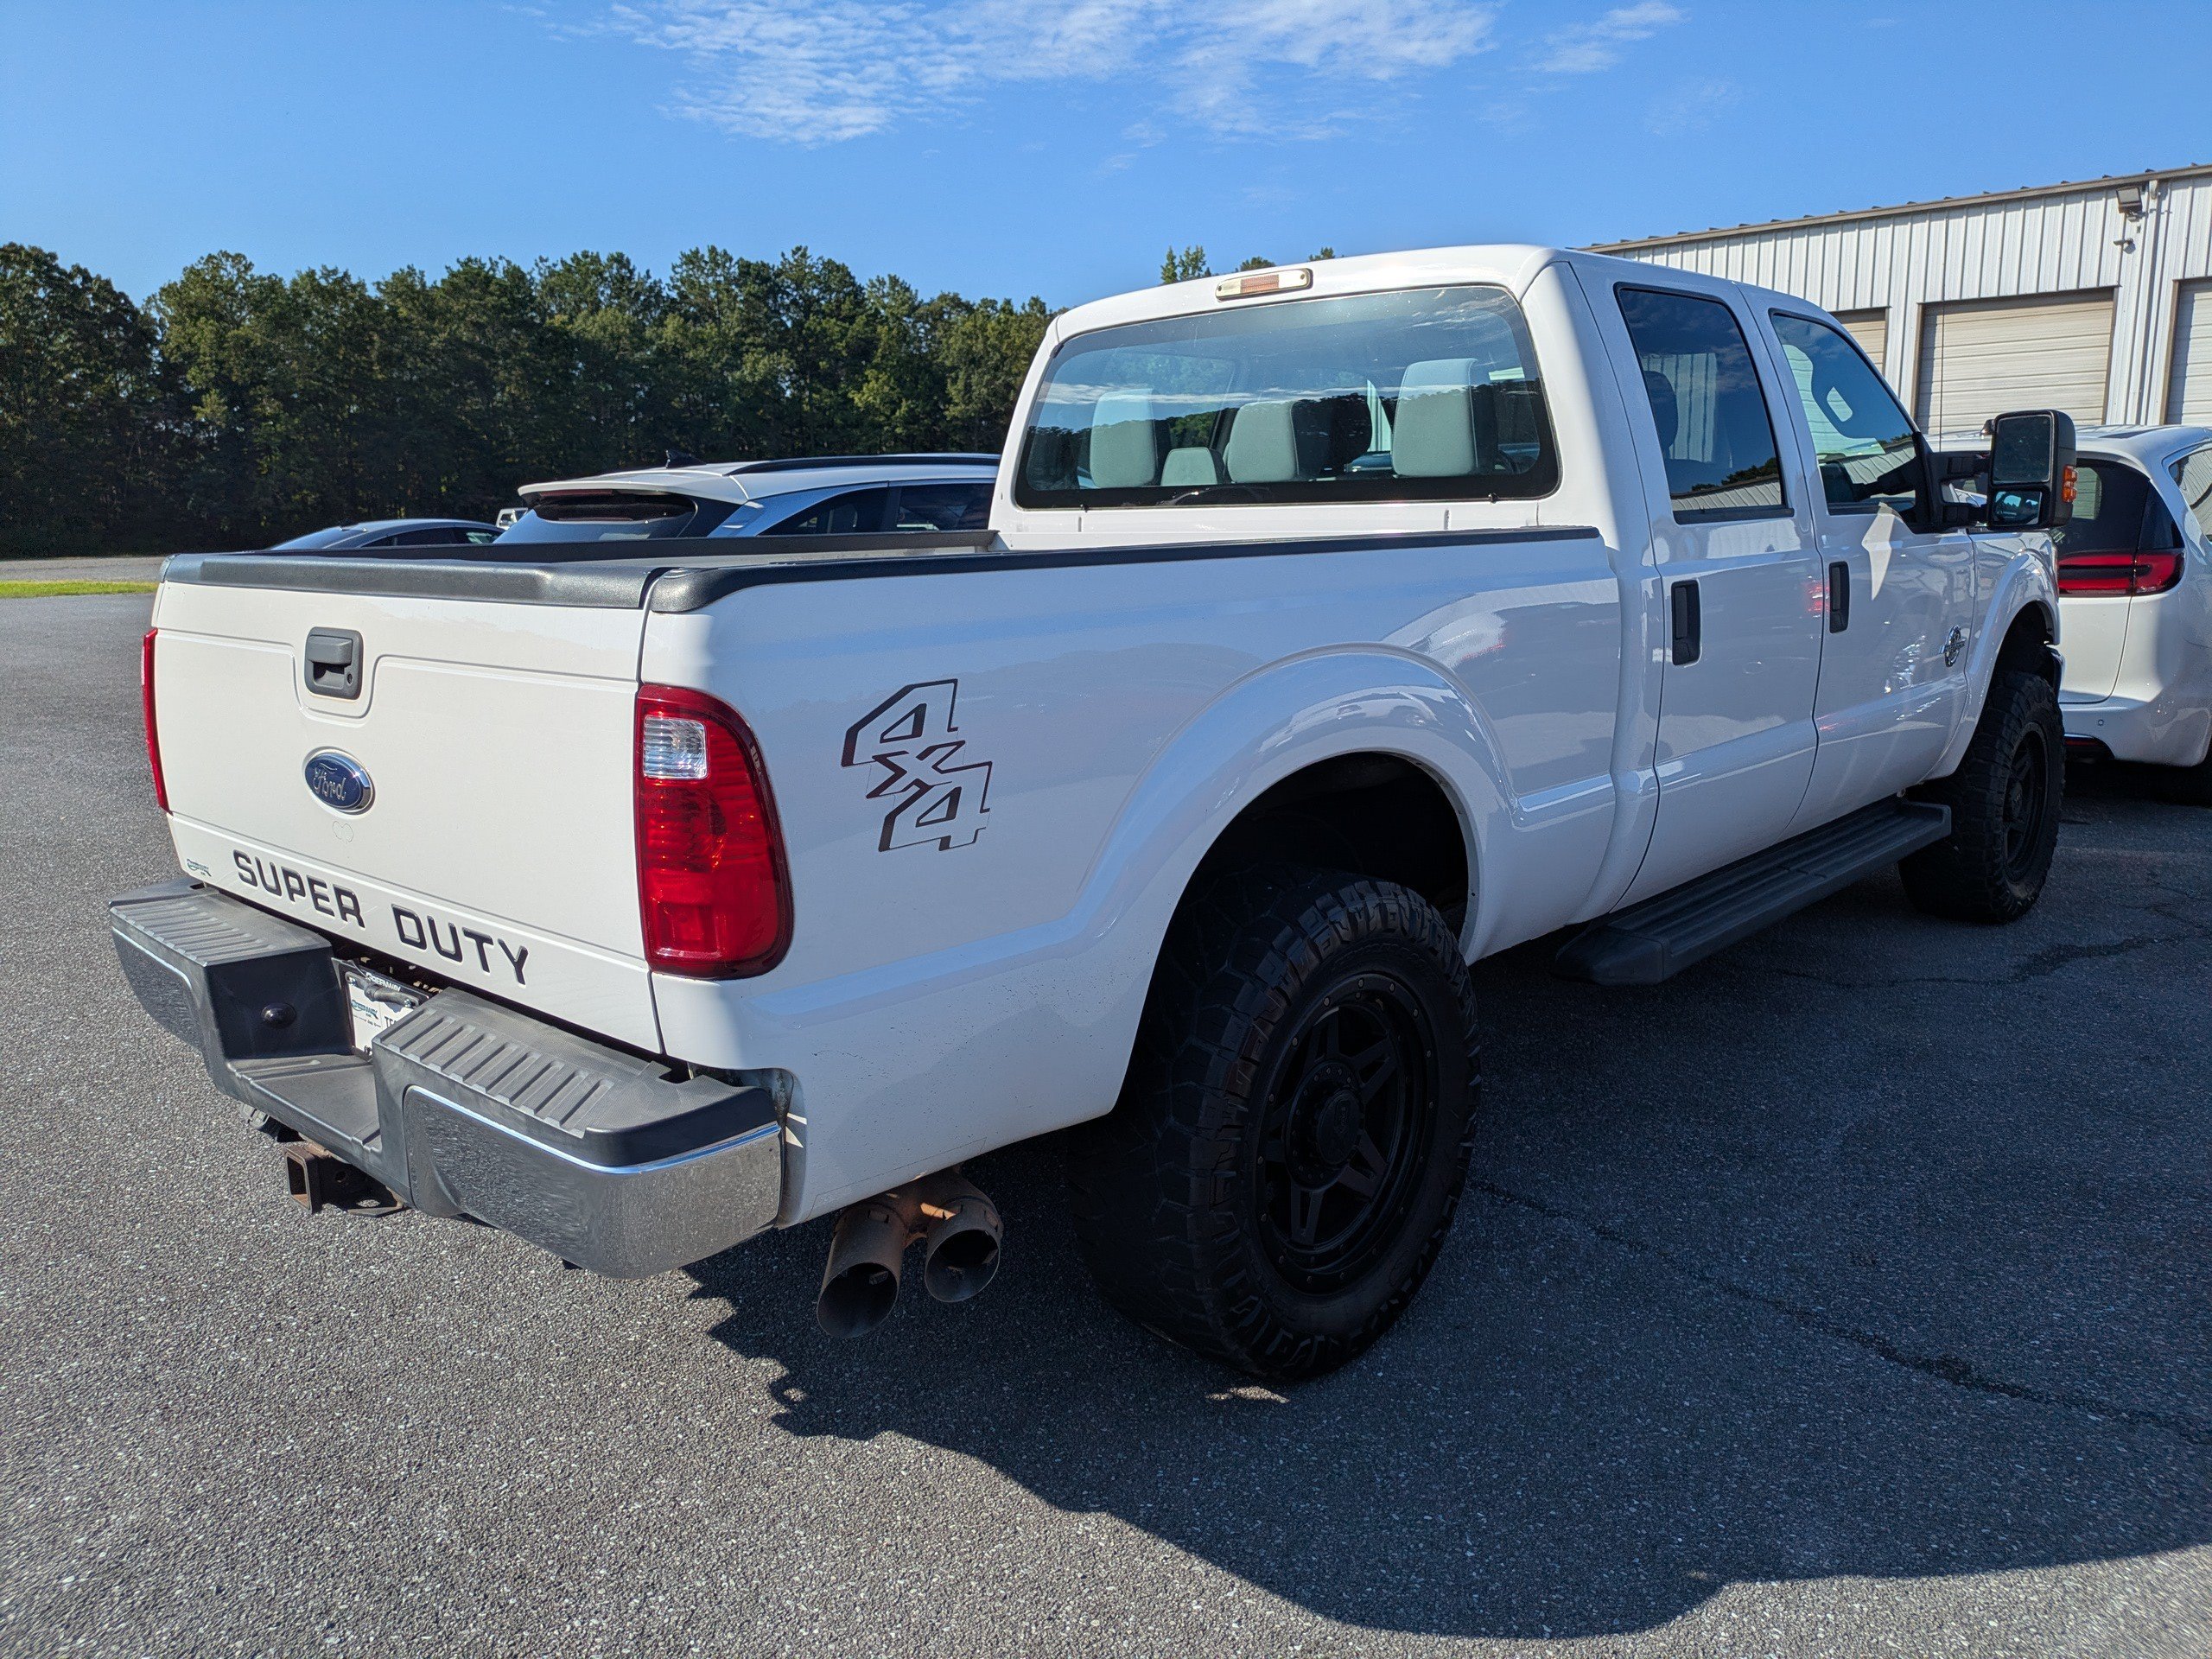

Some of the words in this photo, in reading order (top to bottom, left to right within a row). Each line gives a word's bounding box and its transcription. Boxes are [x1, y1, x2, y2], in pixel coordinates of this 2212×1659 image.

[313, 762, 346, 802] Ford
[232, 849, 366, 930] SUPER
[391, 903, 530, 987] DUTY
